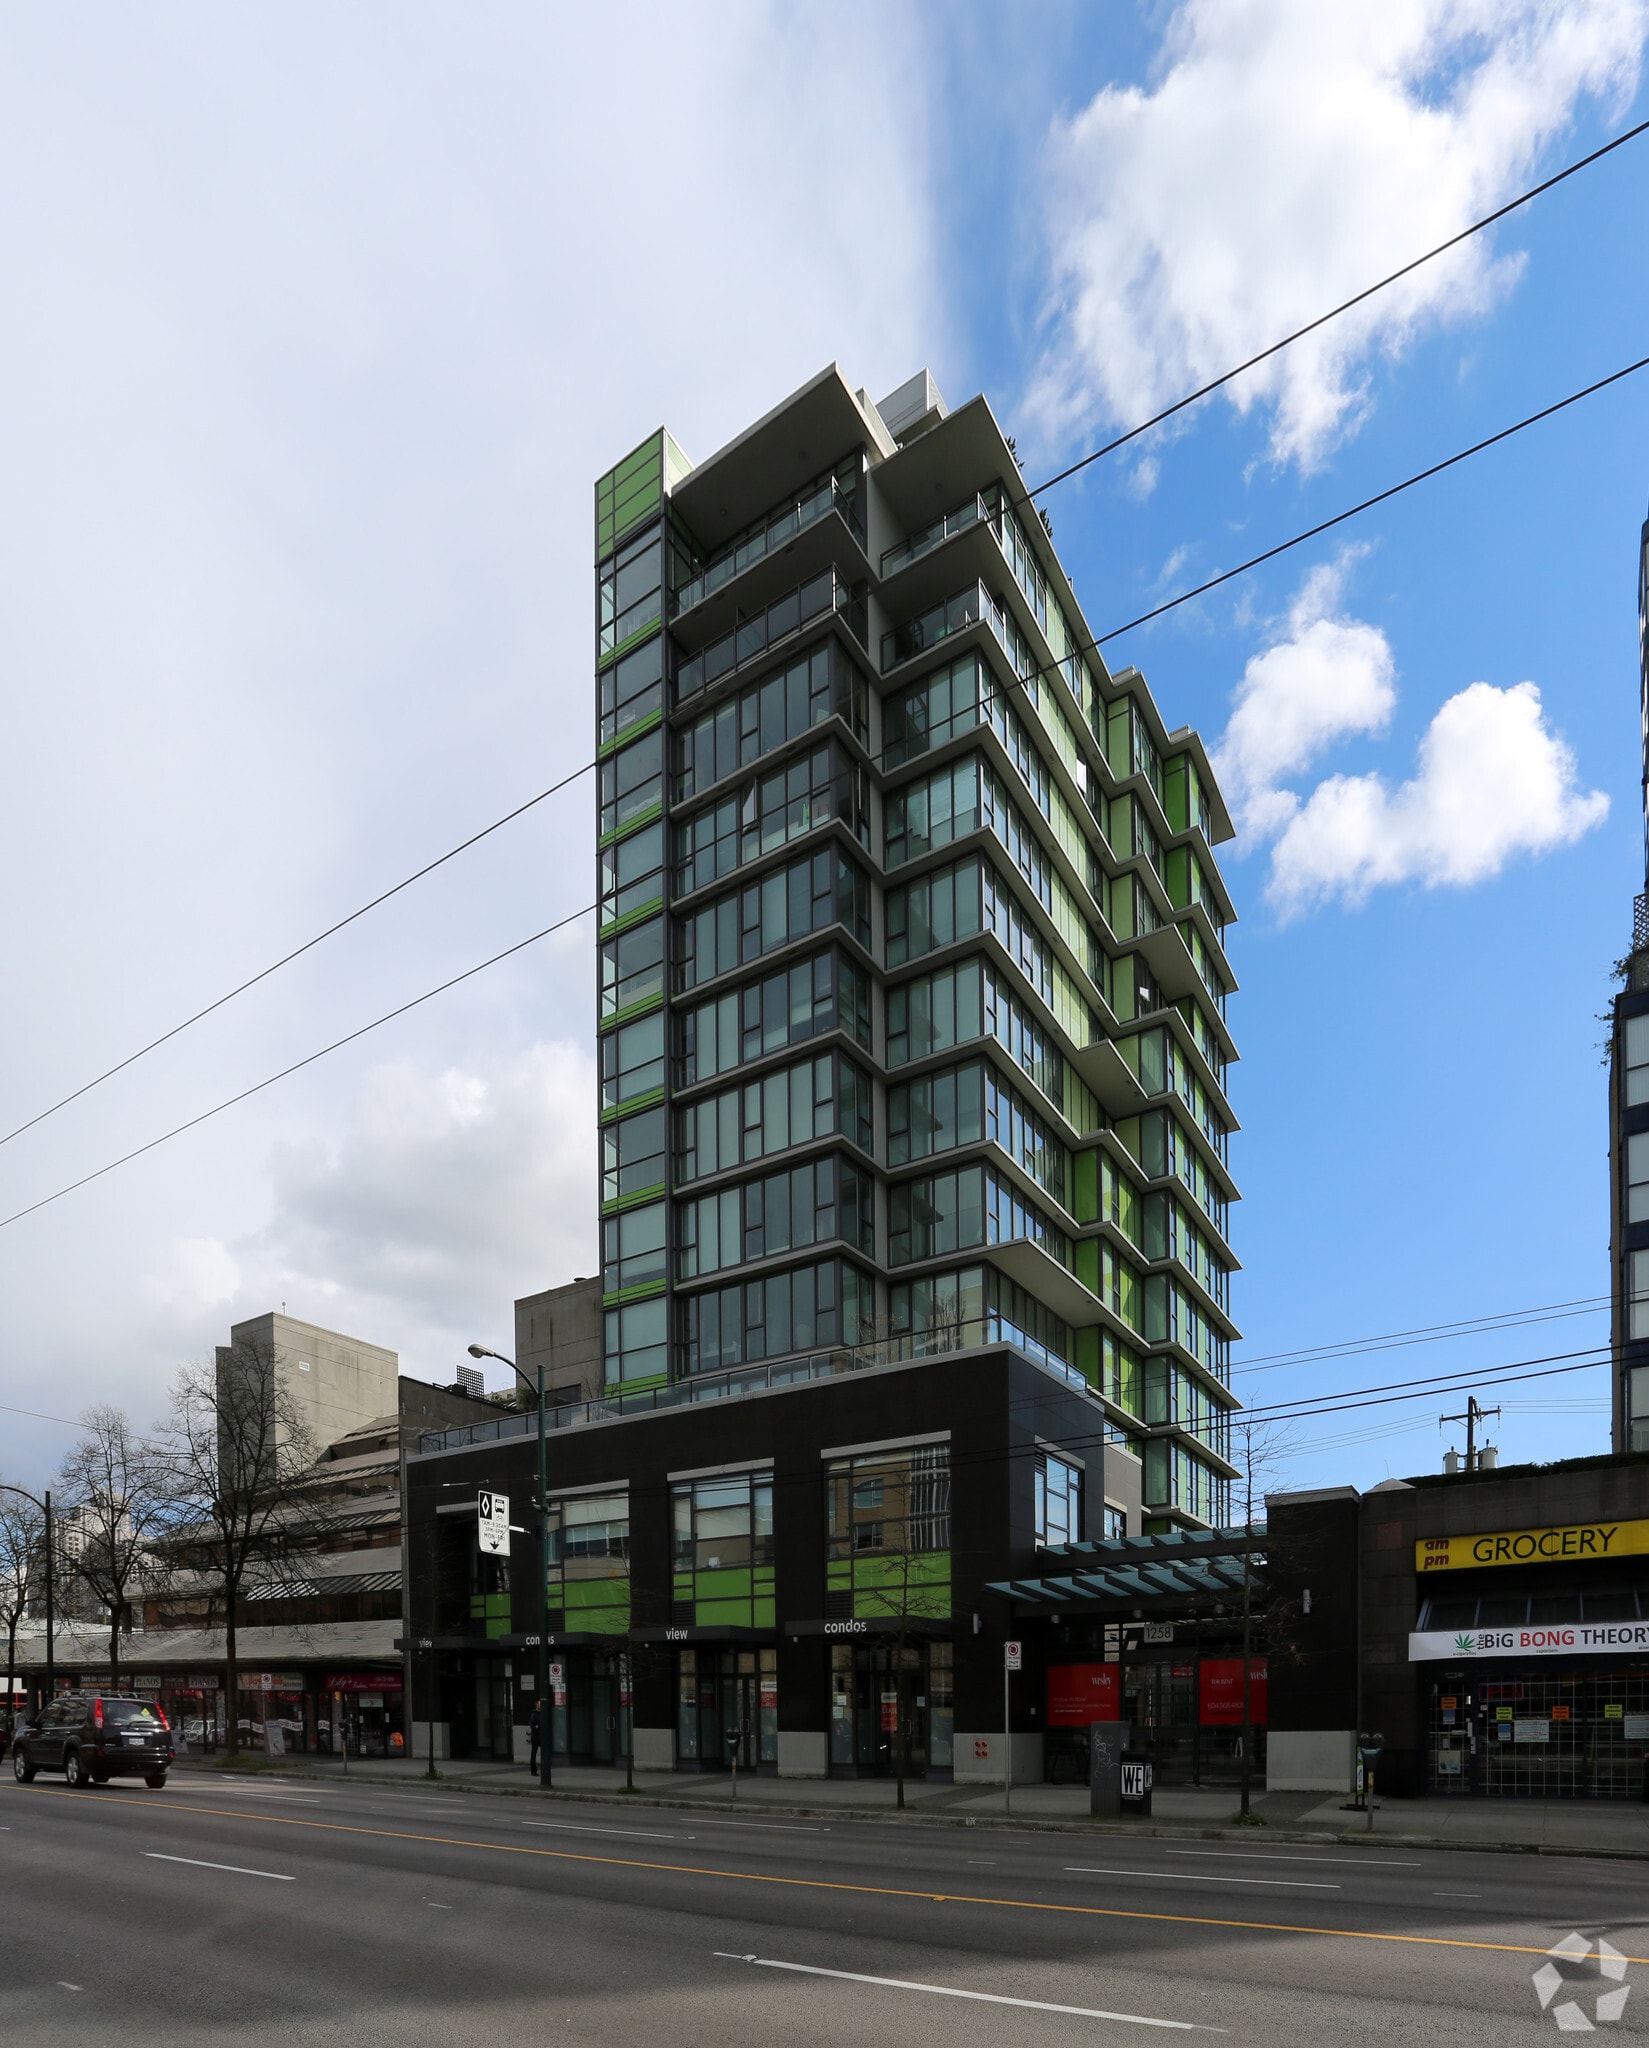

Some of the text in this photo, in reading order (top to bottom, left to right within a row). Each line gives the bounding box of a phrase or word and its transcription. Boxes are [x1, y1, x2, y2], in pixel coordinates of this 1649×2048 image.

[1424, 1539, 1449, 1551] am
[1473, 1527, 1619, 1562] GROCERY
[1424, 1554, 1449, 1570] pm
[665, 1627, 689, 1640] view
[824, 1618, 867, 1634] condos
[1146, 1626, 1172, 1640] 1258
[1477, 1633, 1485, 1650] the
[1485, 1632, 1514, 1649] BiG
[1520, 1629, 1576, 1648] BONG
[136, 1677, 160, 1687] PIANOS
[191, 1677, 217, 1687] PIANOS
[1123, 1766, 1142, 1794] WE
